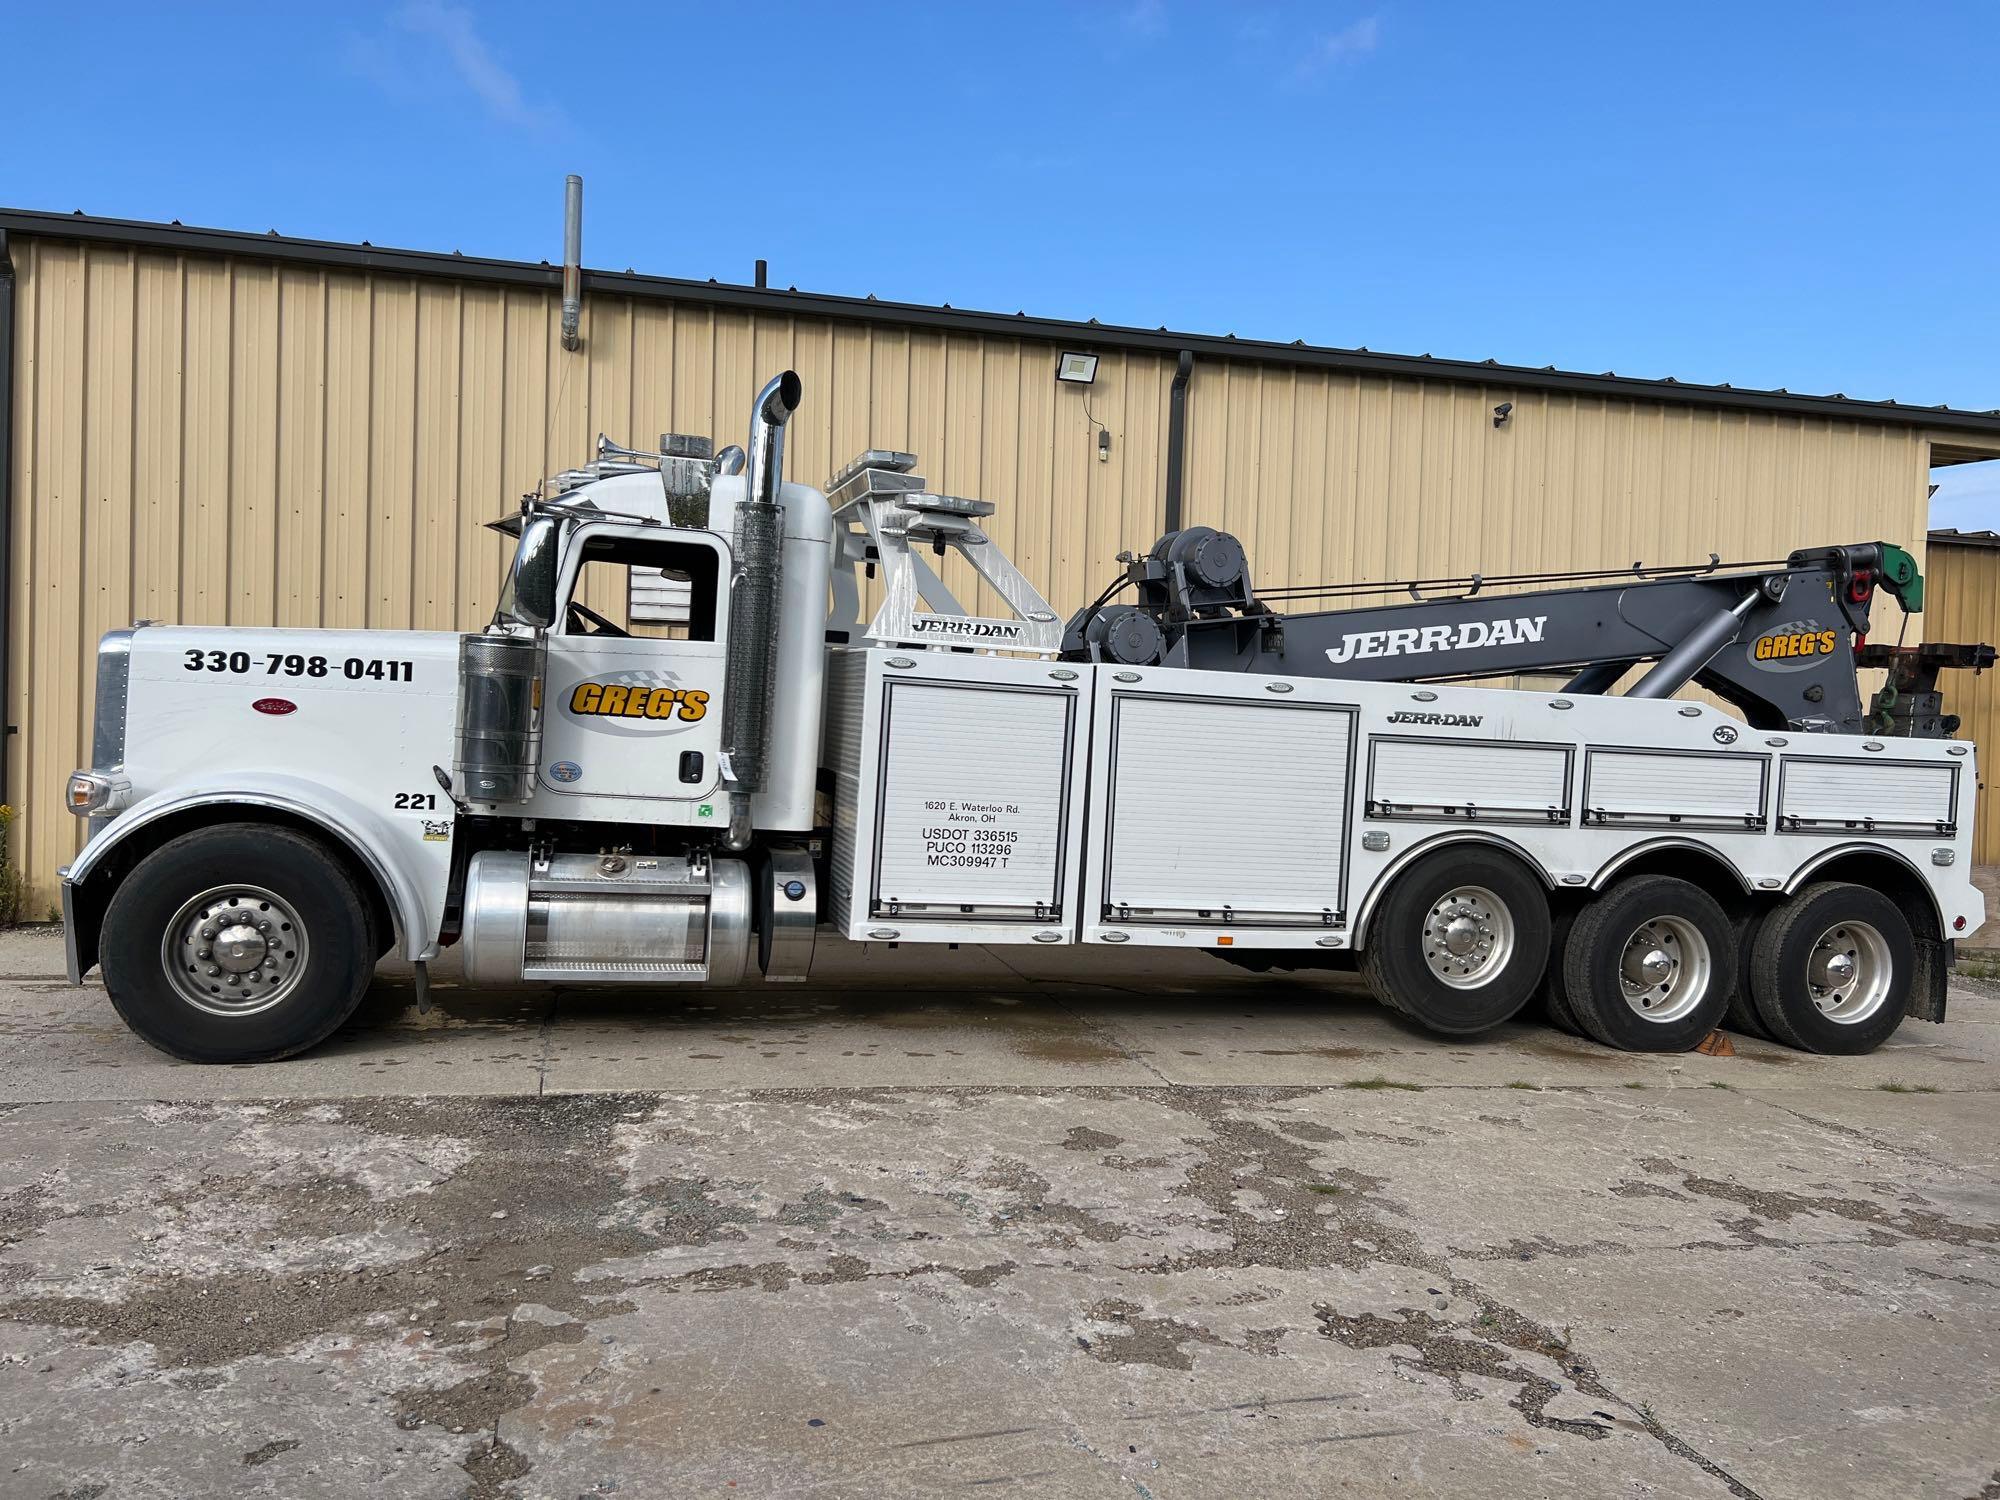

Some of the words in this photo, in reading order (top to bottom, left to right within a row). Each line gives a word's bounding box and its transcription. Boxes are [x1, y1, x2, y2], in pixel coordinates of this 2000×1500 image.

[912, 620, 1020, 638] JERR-DAN
[1325, 616, 1548, 663] JERR-DAN
[1755, 630, 1836, 661] GREG'S
[184, 649, 413, 682] 330-798-0411
[569, 683, 710, 722] GREG'S
[1386, 711, 1484, 727] JERR-DAN
[394, 793, 435, 810] 221
[925, 801, 946, 811] 1620
[949, 802, 958, 811] E.
[961, 803, 1003, 813] Waterloo
[1006, 805, 1020, 813] Rd.
[948, 813, 977, 823] Akron,
[981, 814, 996, 823] OH
[922, 828, 969, 840] USDOT
[973, 830, 1018, 842] 336515
[926, 842, 966, 853] PUCO
[971, 843, 1012, 855] 113296
[927, 855, 997, 868] MC309947
[1002, 858, 1009, 868] T
